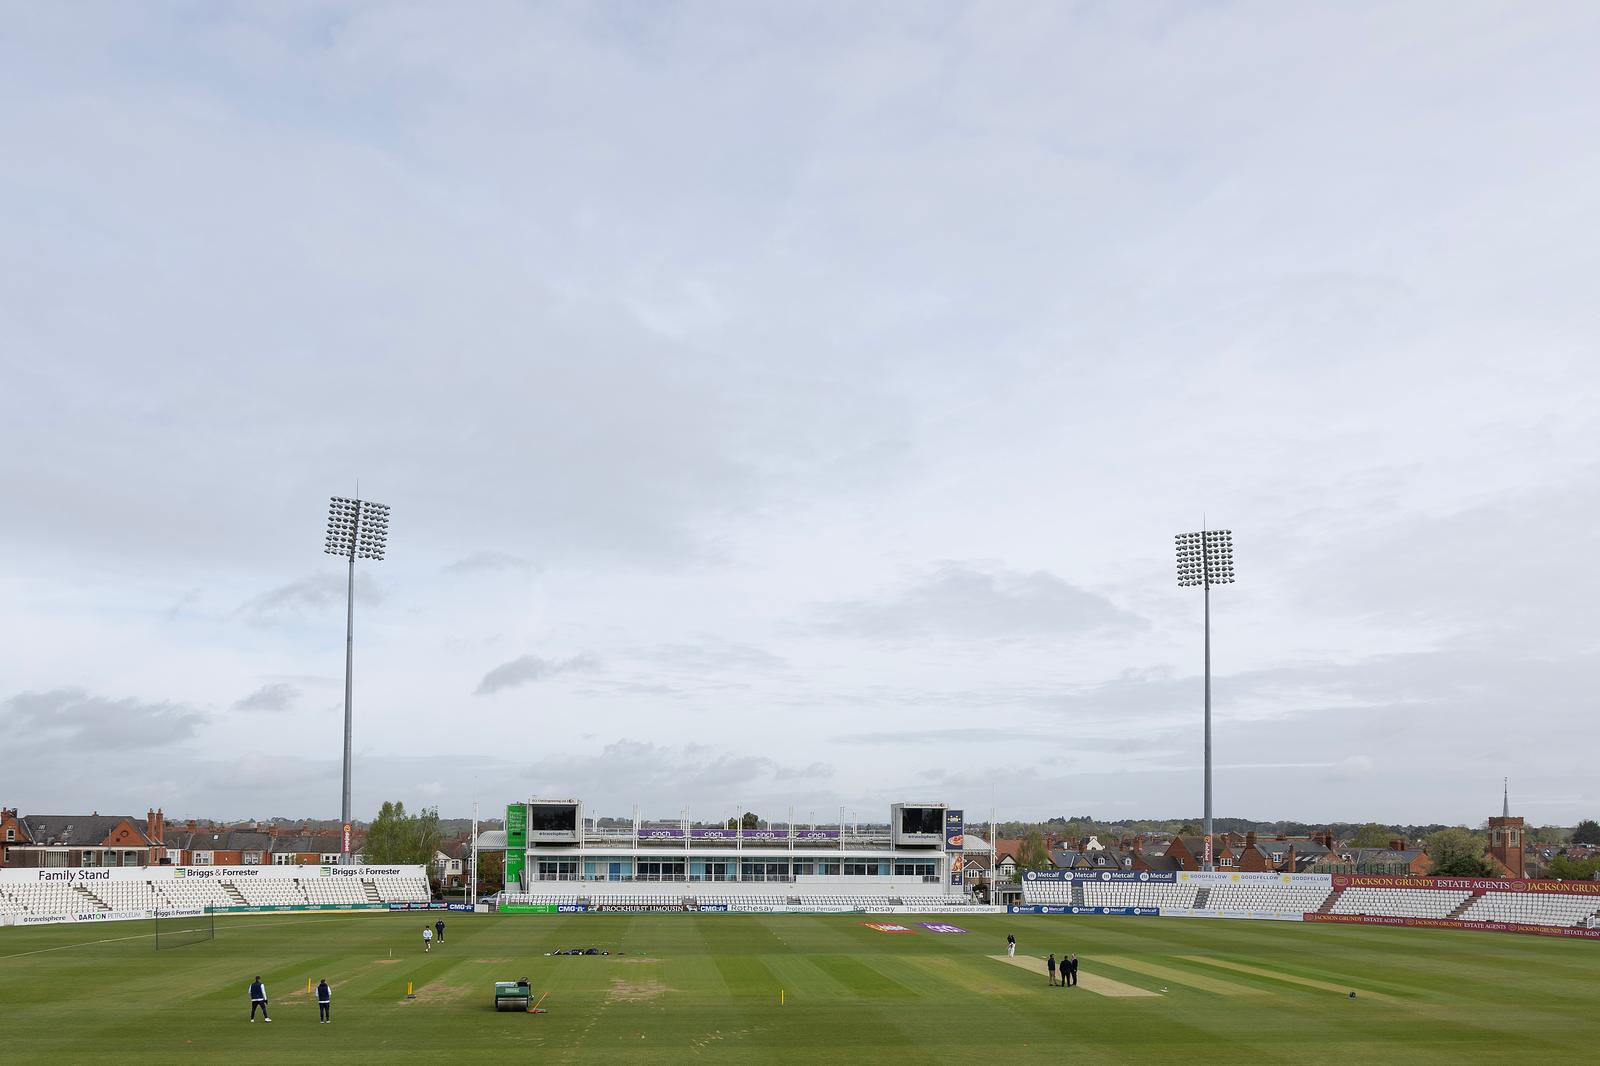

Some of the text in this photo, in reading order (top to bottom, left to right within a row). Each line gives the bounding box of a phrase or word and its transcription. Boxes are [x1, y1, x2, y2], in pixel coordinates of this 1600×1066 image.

[39, 869, 110, 882] Family Stand
[187, 869, 214, 878] Briggs
[332, 868, 357, 876] Briggs
[1396, 878, 1434, 886] GRUNDY
[1437, 880, 1470, 888] ESTATE
[1472, 881, 1510, 889] AGENTS
[1526, 882, 1570, 891] JACKSON
